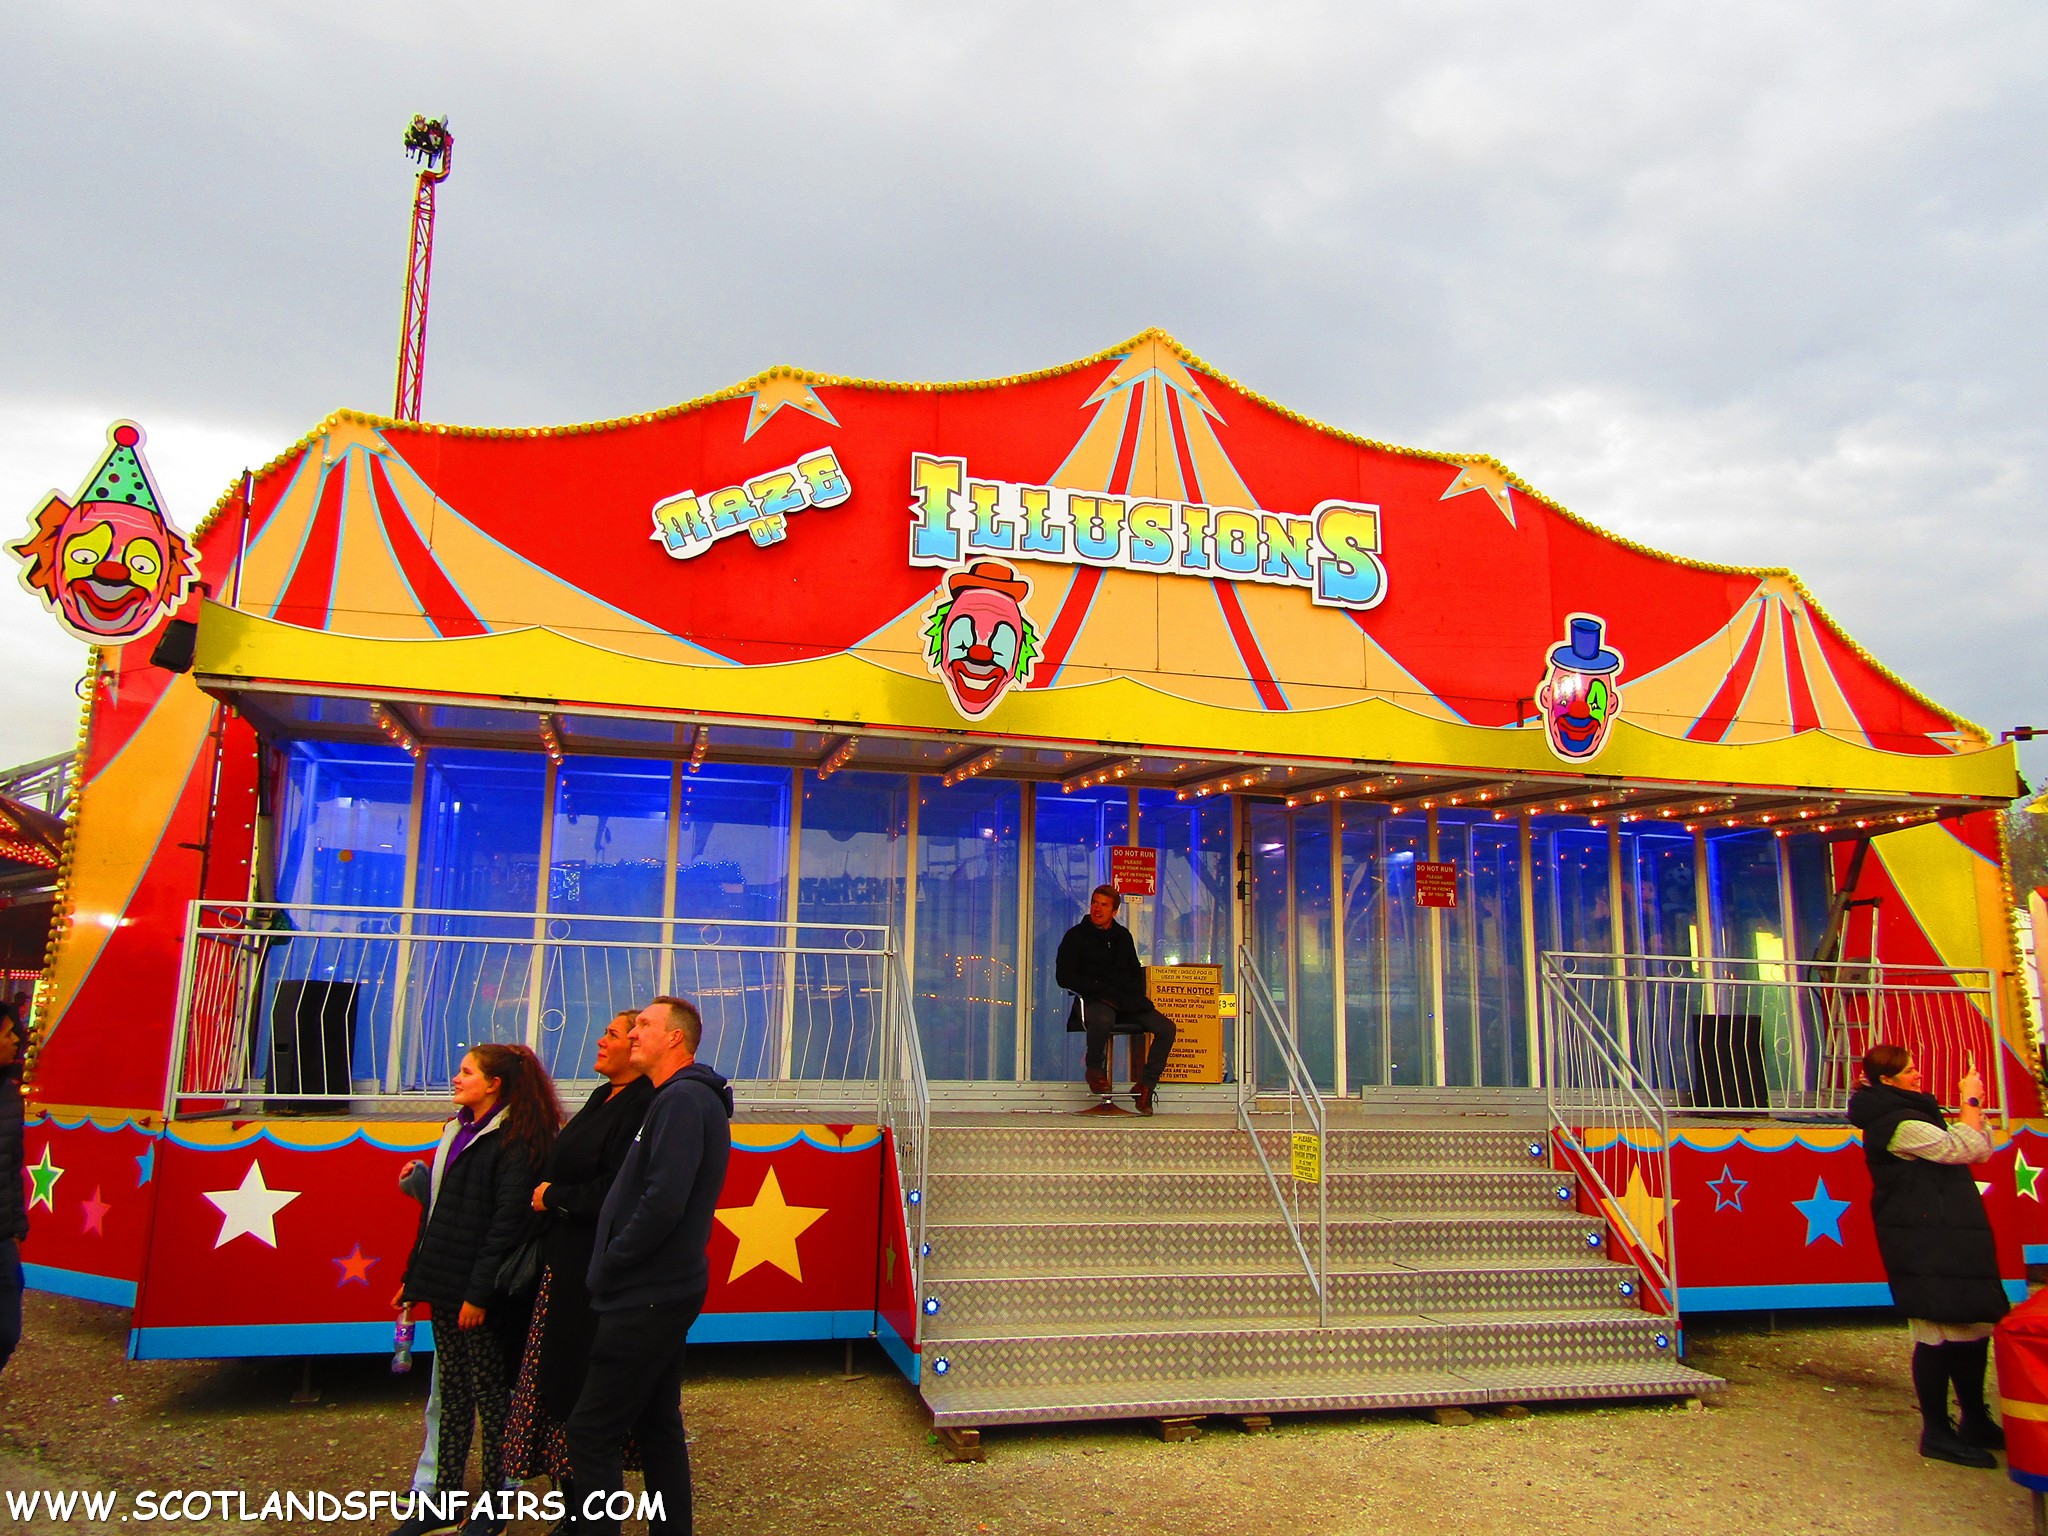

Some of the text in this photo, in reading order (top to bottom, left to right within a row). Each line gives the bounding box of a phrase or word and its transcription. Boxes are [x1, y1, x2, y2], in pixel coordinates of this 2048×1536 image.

[655, 454, 848, 551] MAZE
[749, 514, 783, 546] OF
[912, 455, 1381, 604] ILLUSIONS
[1156, 985, 1215, 996] SAFETY NOTICE
